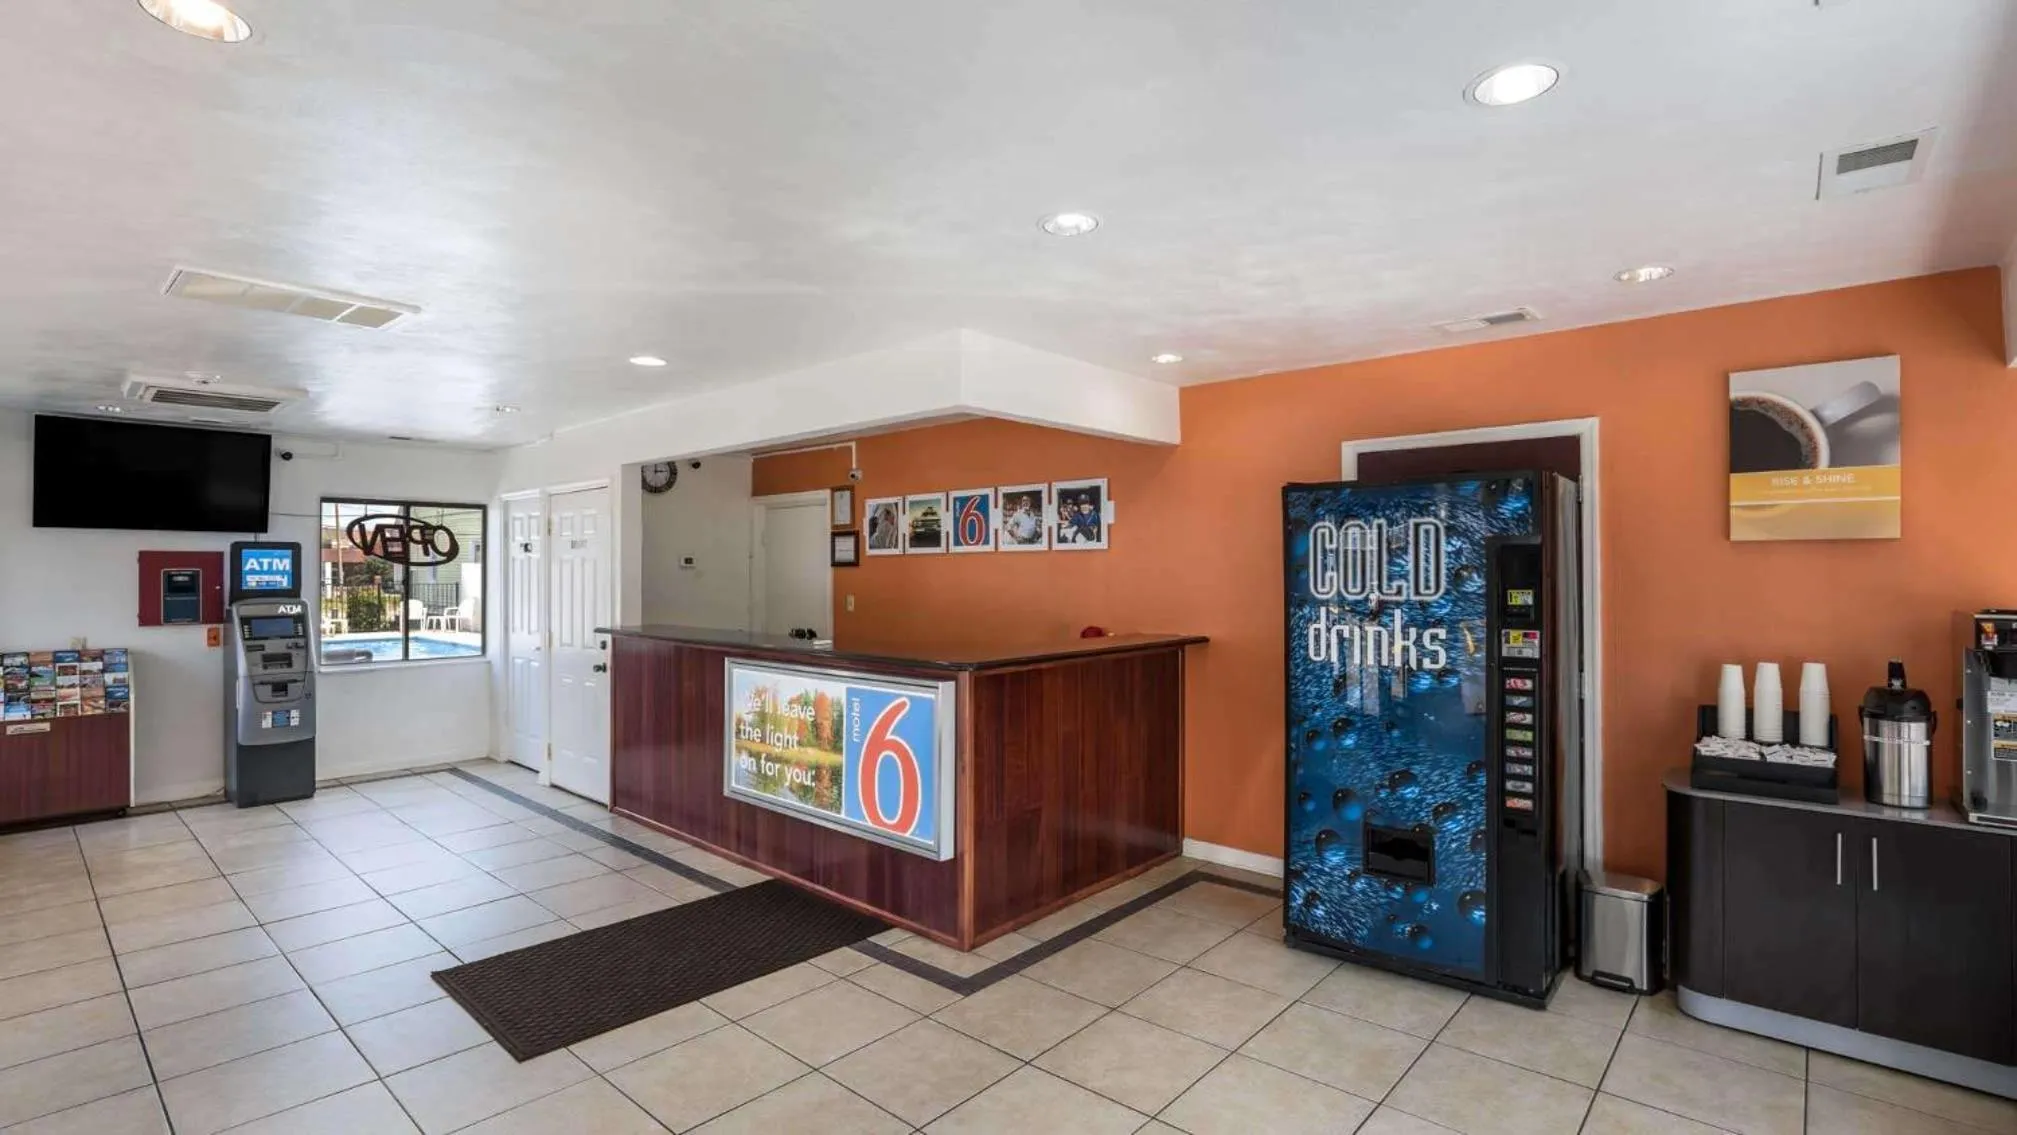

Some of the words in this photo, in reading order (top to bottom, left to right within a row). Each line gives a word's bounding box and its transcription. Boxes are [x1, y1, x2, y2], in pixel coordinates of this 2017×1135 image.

[1816, 473, 1857, 484] SHINE
[959, 495, 985, 547] 6
[244, 558, 290, 571] ATM
[1309, 518, 1446, 601] COLD
[278, 605, 302, 614] ATM
[1308, 606, 1447, 671] drinks
[739, 724, 762, 743] the
[765, 725, 799, 750] light
[851, 697, 861, 743] motel
[740, 754, 757, 771] on
[761, 754, 780, 777] for
[858, 696, 922, 836] 6
